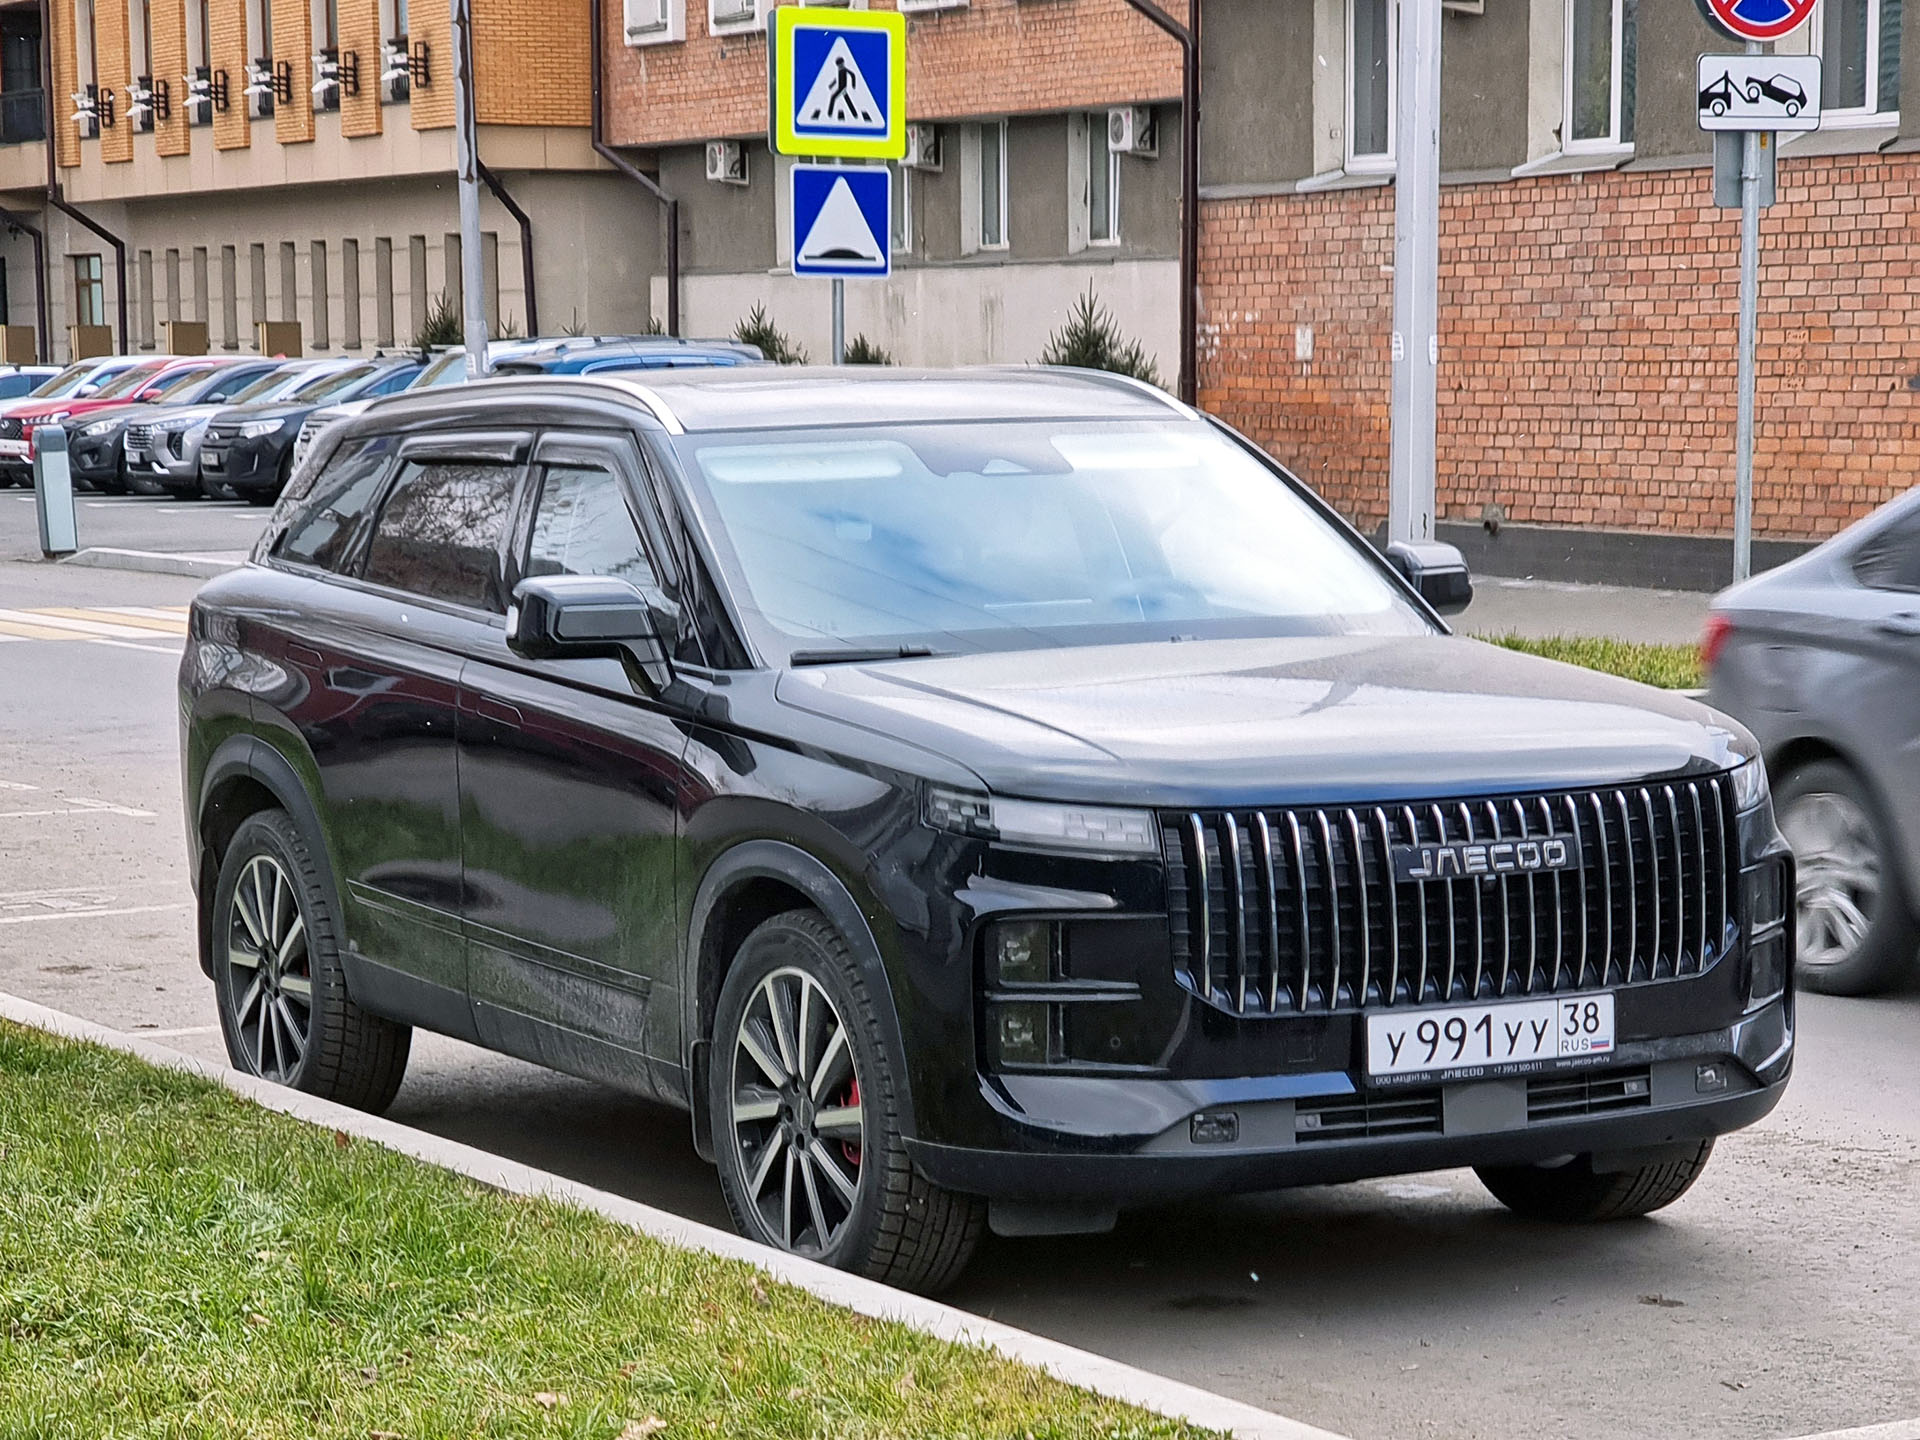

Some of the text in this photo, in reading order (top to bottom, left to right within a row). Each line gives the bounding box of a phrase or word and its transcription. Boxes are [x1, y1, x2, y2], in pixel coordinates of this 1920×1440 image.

[1408, 839, 1567, 878] JAECOO
[1563, 1002, 1600, 1036] 38
[1561, 1038, 1589, 1052] RUS
[1441, 1067, 1485, 1080] JAECOO
